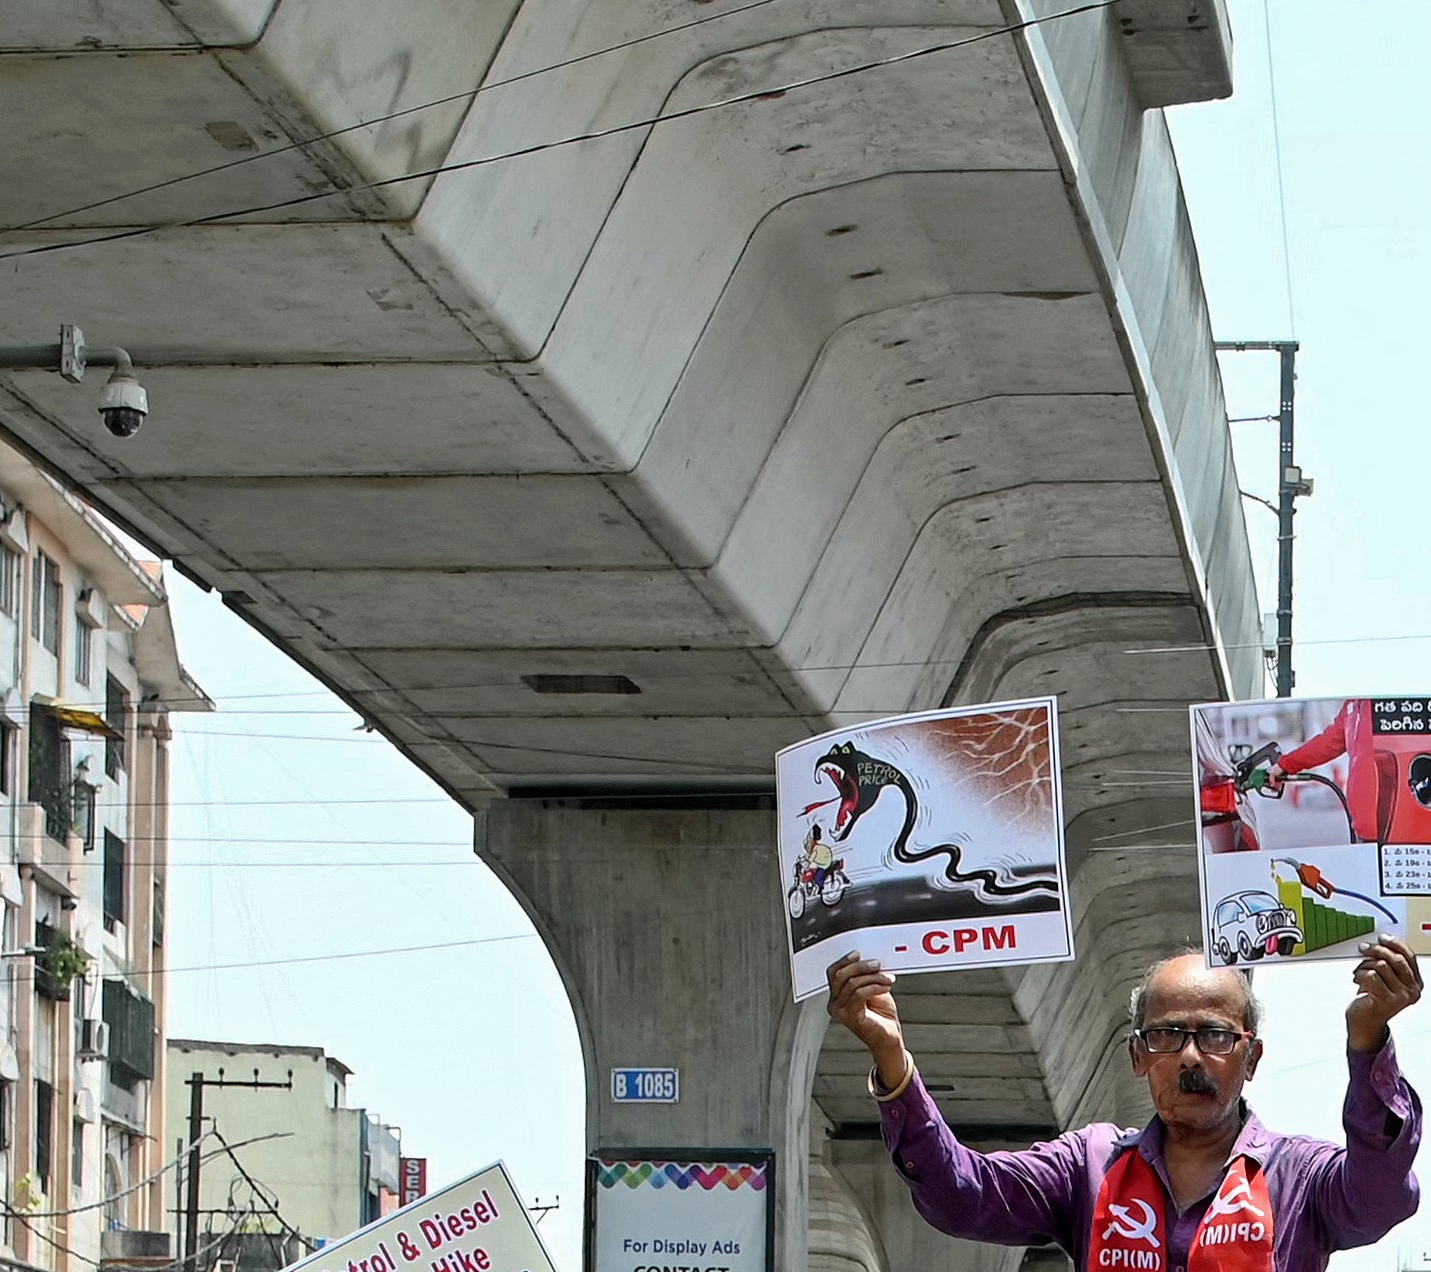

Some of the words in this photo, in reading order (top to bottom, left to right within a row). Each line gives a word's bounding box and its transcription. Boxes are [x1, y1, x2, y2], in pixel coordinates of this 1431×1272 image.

[857, 763, 901, 785] PETROL
[859, 776, 888, 786] PRICE
[922, 925, 1016, 954] CPM
[615, 1073, 628, 1096] B
[634, 1072, 675, 1097] 1085
[396, 1230, 420, 1262] &
[418, 1189, 500, 1252] Diesel
[623, 1238, 649, 1254] For
[653, 1238, 707, 1257] Display
[711, 1238, 741, 1254] Ads
[1099, 1248, 1161, 1271] CPI(M)
